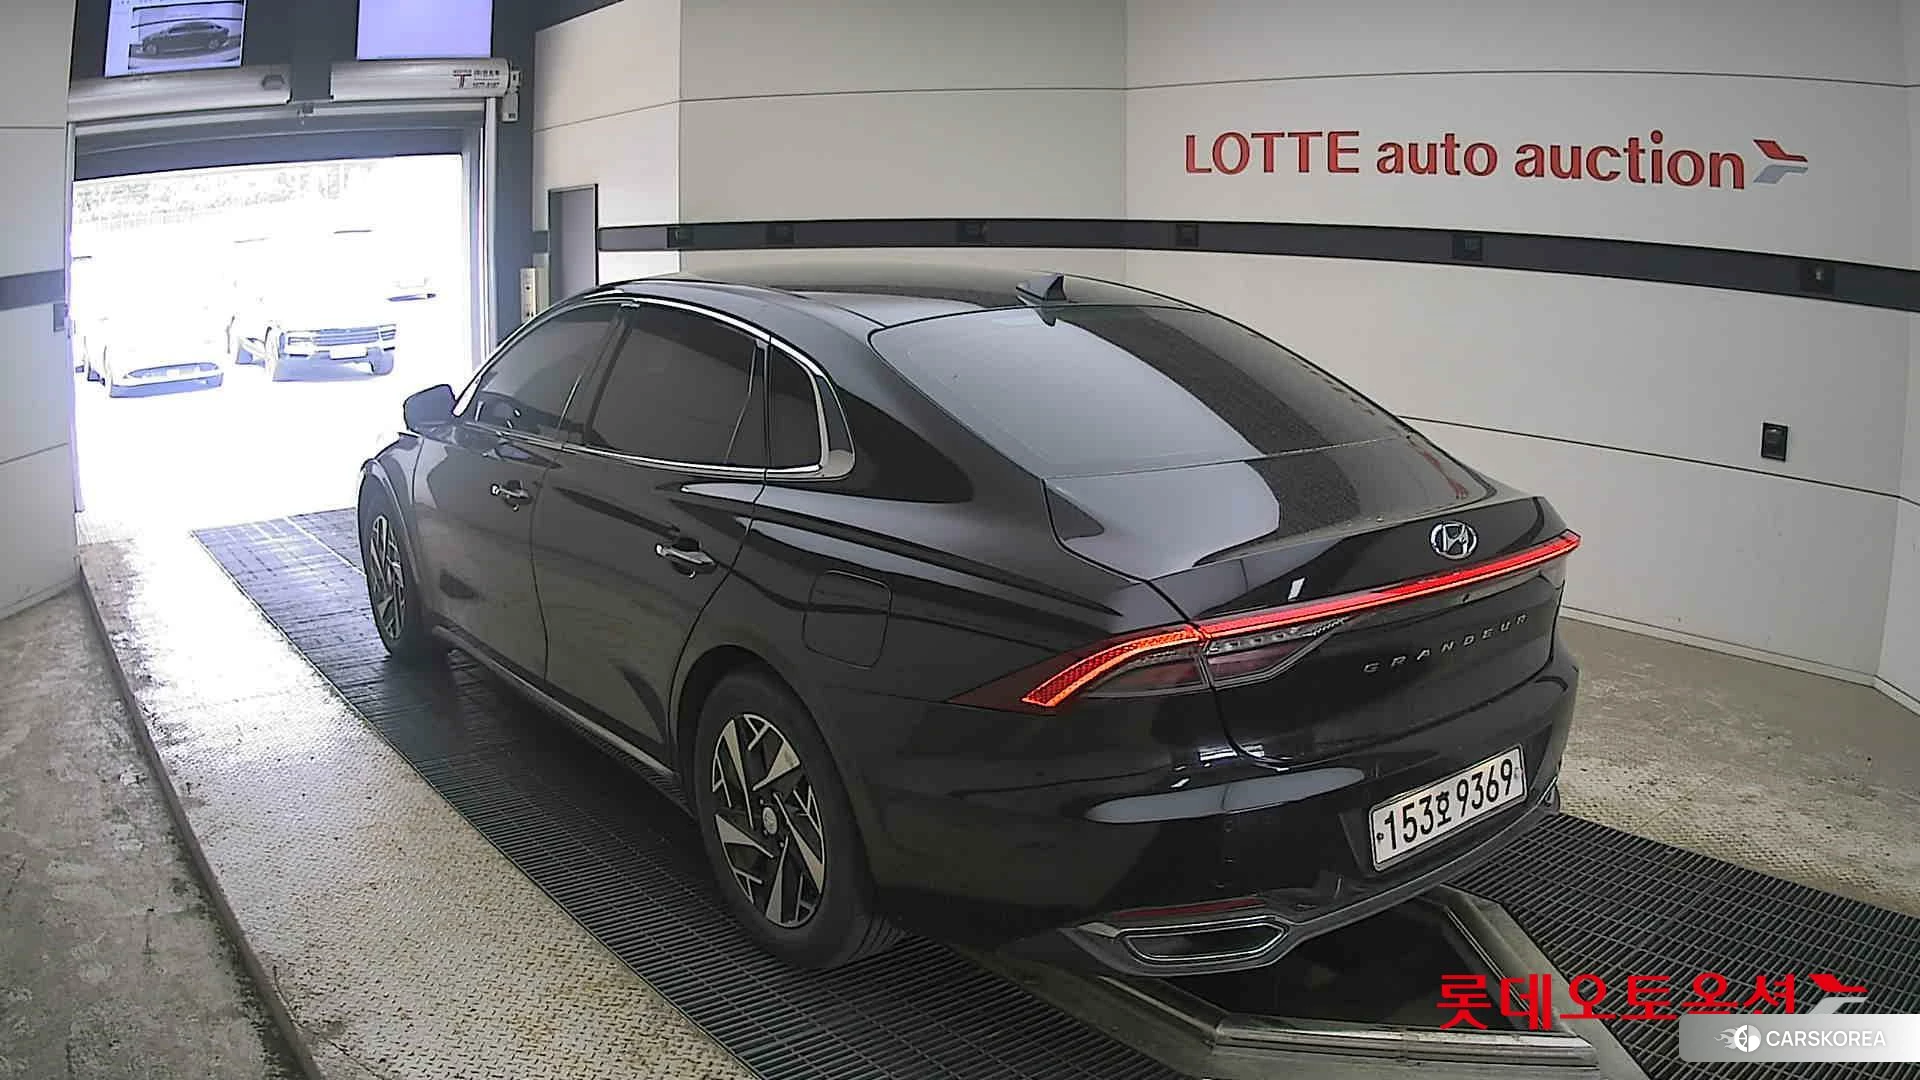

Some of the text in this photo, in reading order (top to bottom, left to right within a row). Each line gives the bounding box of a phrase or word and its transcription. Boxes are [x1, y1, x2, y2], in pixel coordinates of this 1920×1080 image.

[1186, 130, 1746, 189] LOTTE auto auction
[1362, 613, 1529, 673] GRANDEUR
